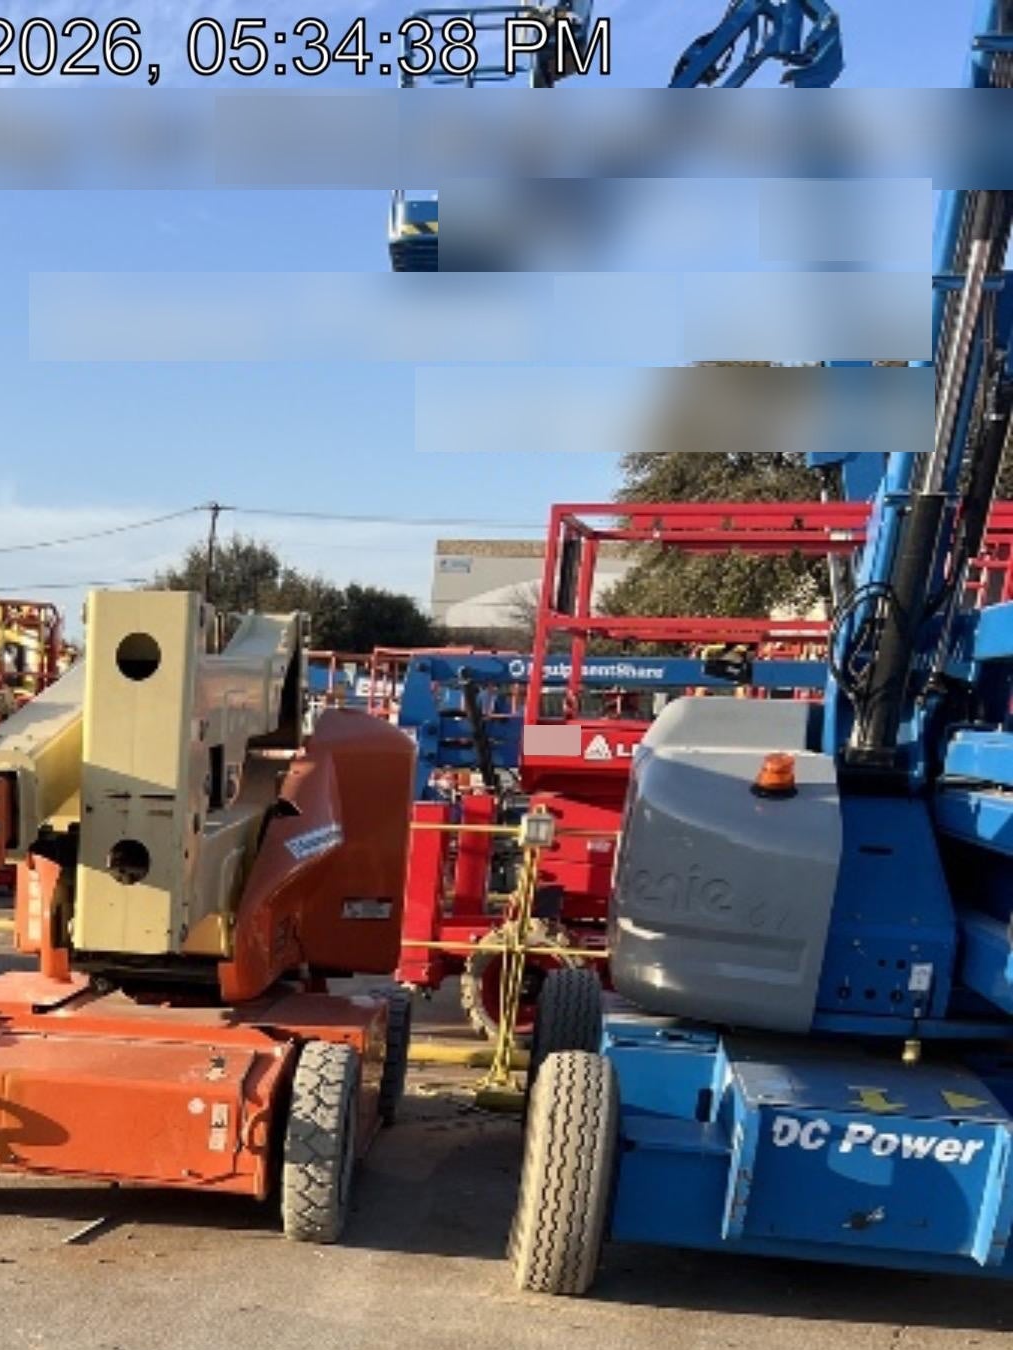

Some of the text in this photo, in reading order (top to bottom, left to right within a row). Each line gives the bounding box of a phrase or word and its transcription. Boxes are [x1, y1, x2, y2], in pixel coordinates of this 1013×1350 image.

[528, 662, 664, 679] quipentShare
[772, 1116, 984, 1165] DC Power
